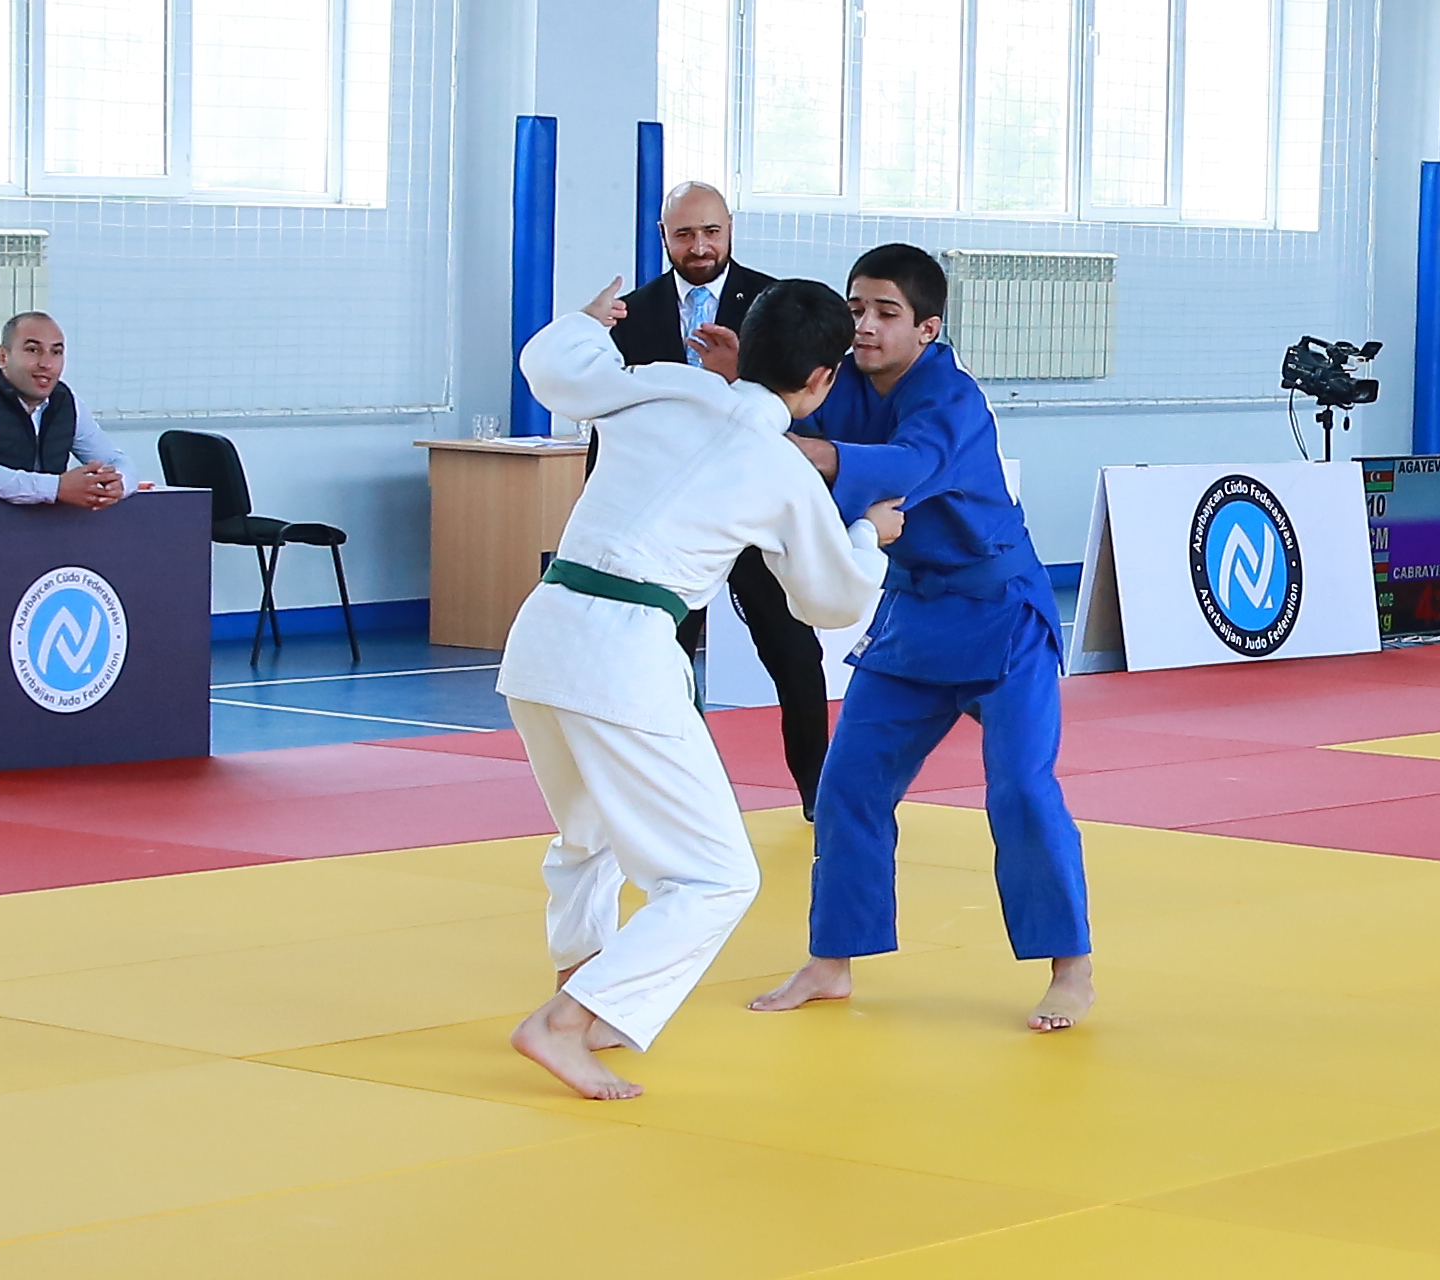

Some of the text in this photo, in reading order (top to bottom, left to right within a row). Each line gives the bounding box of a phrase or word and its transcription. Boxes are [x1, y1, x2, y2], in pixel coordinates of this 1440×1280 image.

[1199, 583, 1300, 650] Azerbaijan Judo Federation
[18, 652, 121, 706] Azerbaijan Judo Federation
